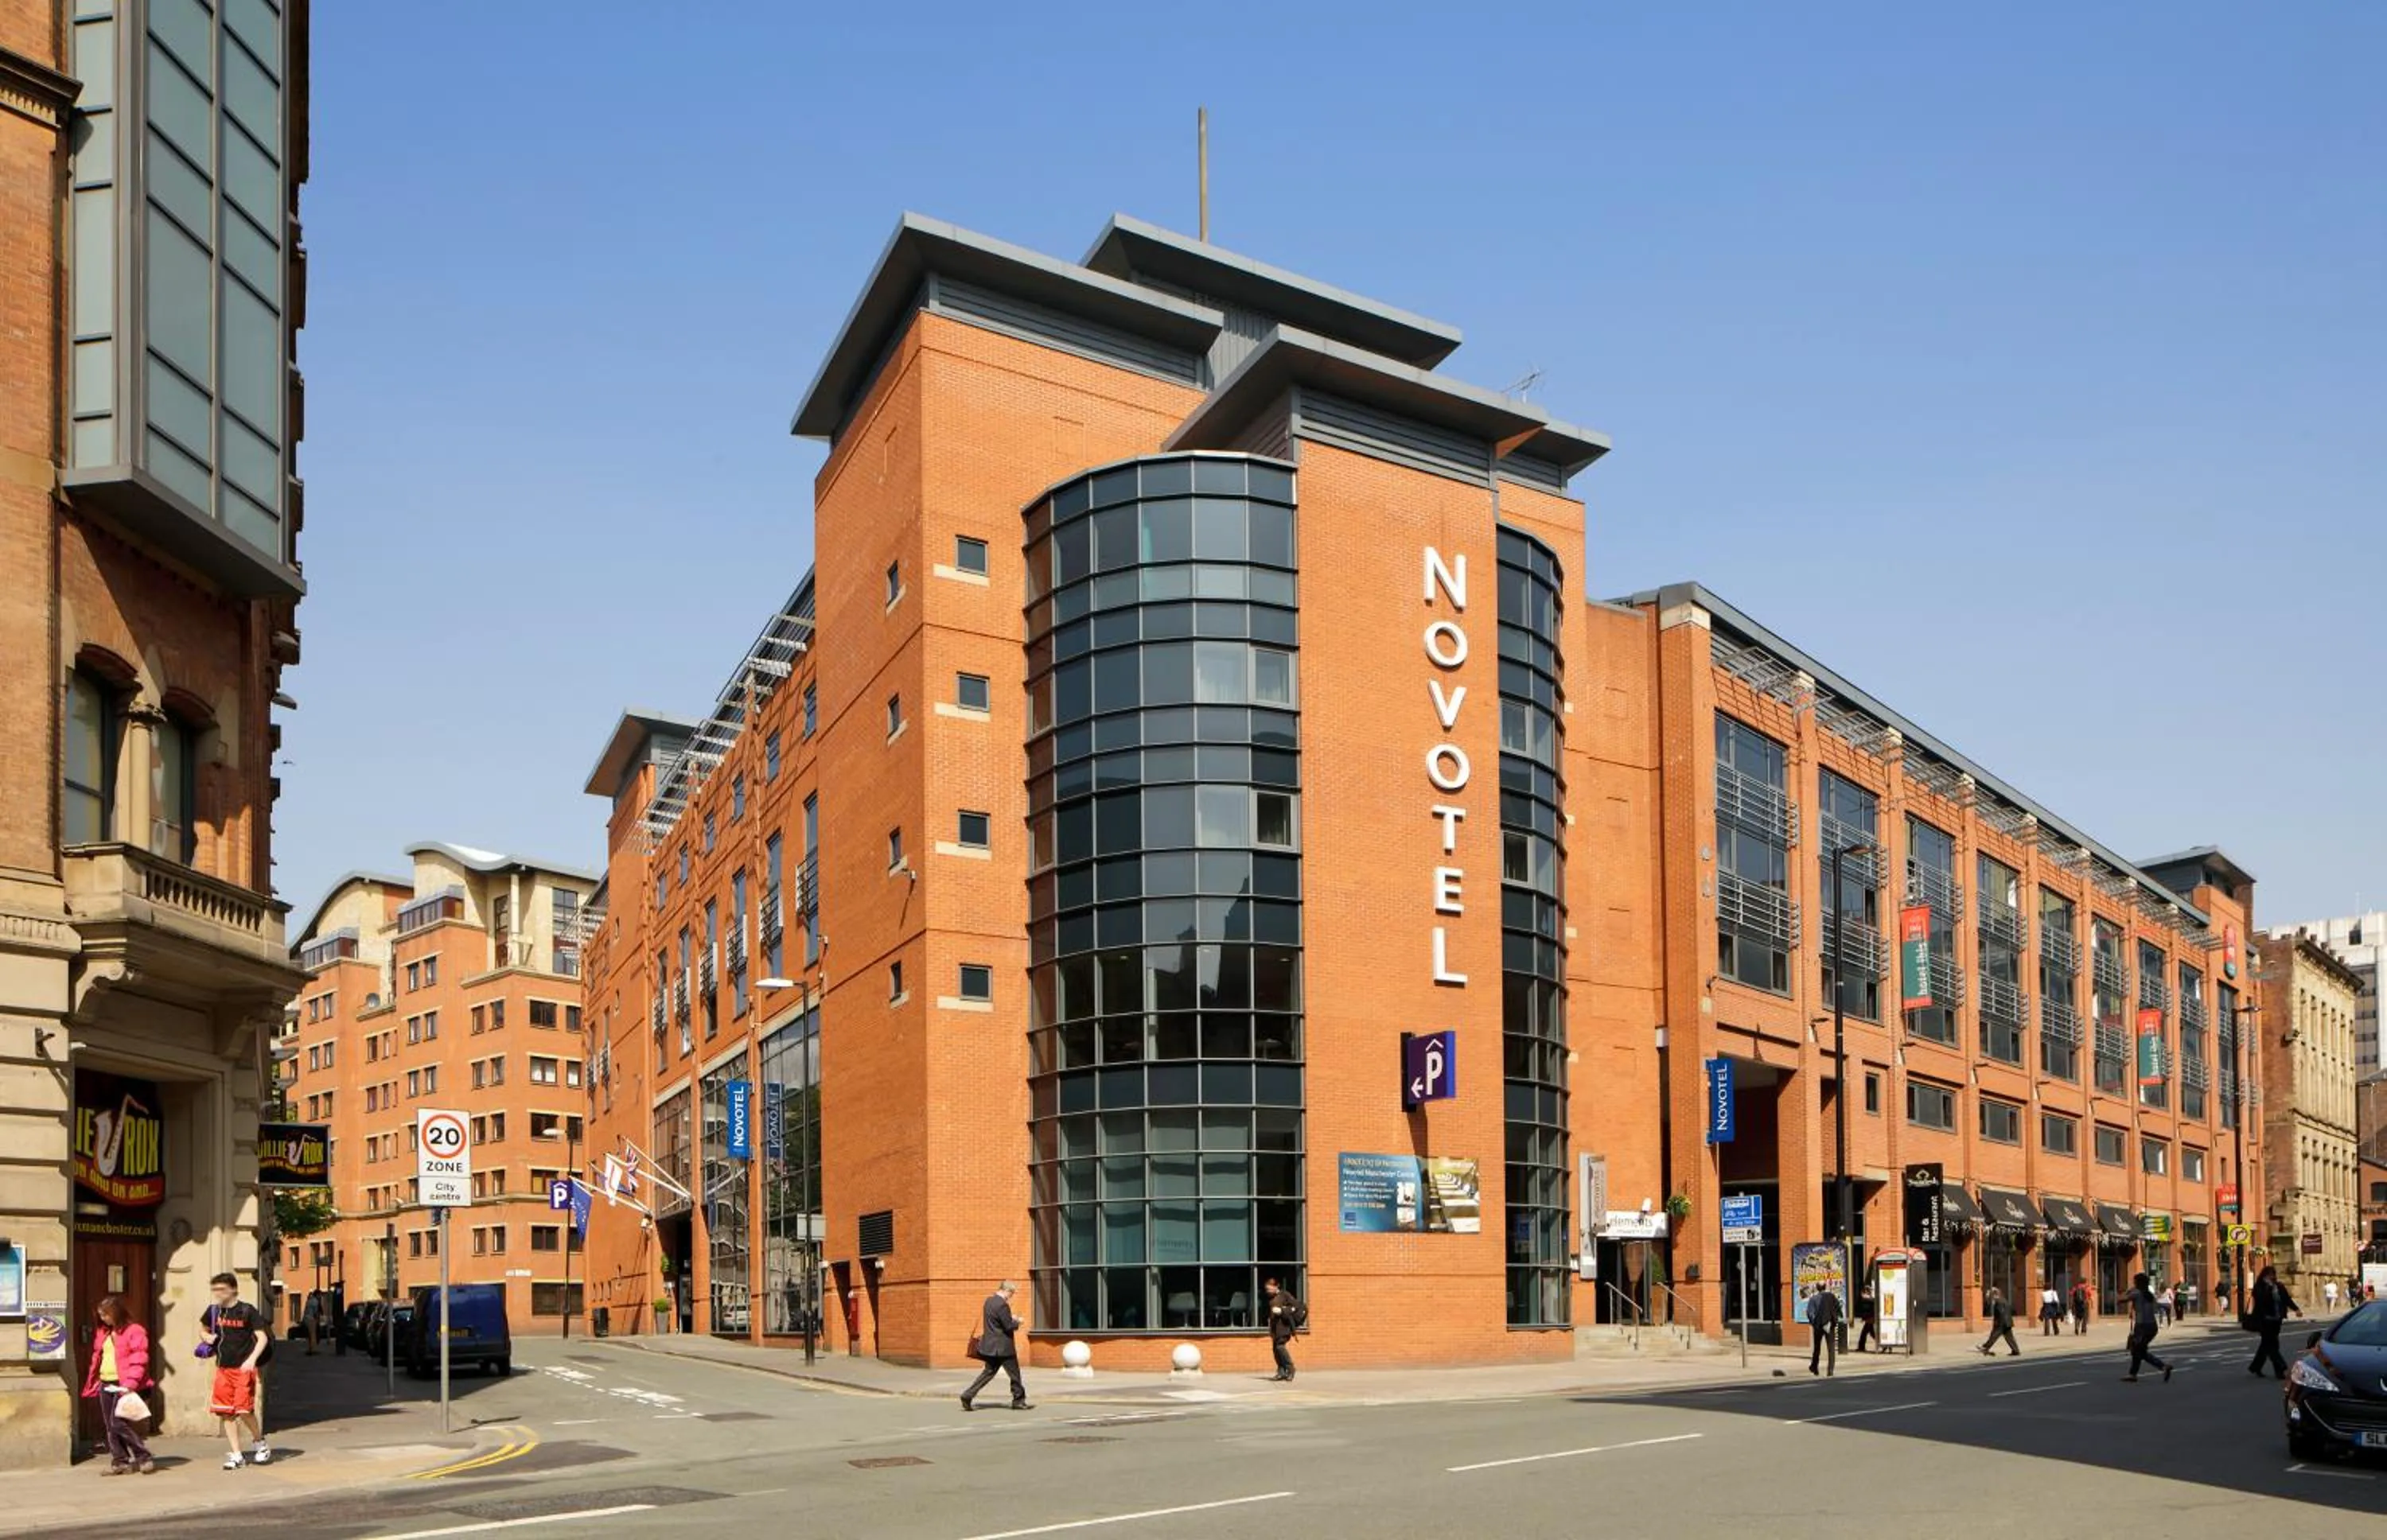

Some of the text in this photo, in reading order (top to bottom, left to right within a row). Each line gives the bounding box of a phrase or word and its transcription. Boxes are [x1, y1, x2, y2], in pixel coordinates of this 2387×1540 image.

[1423, 546, 1470, 986] NOVOTEL
[1426, 1051, 1443, 1095] P
[1716, 1062, 1727, 1130] NOVOTEL
[733, 1086, 744, 1146] NOVOTEL
[75, 1106, 160, 1176] IE ROX
[430, 1127, 460, 1145] 20
[426, 1161, 464, 1172] ZONE
[435, 1181, 456, 1192] City
[553, 1188, 567, 1208] P
[2366, 1433, 2387, 1445] SL
